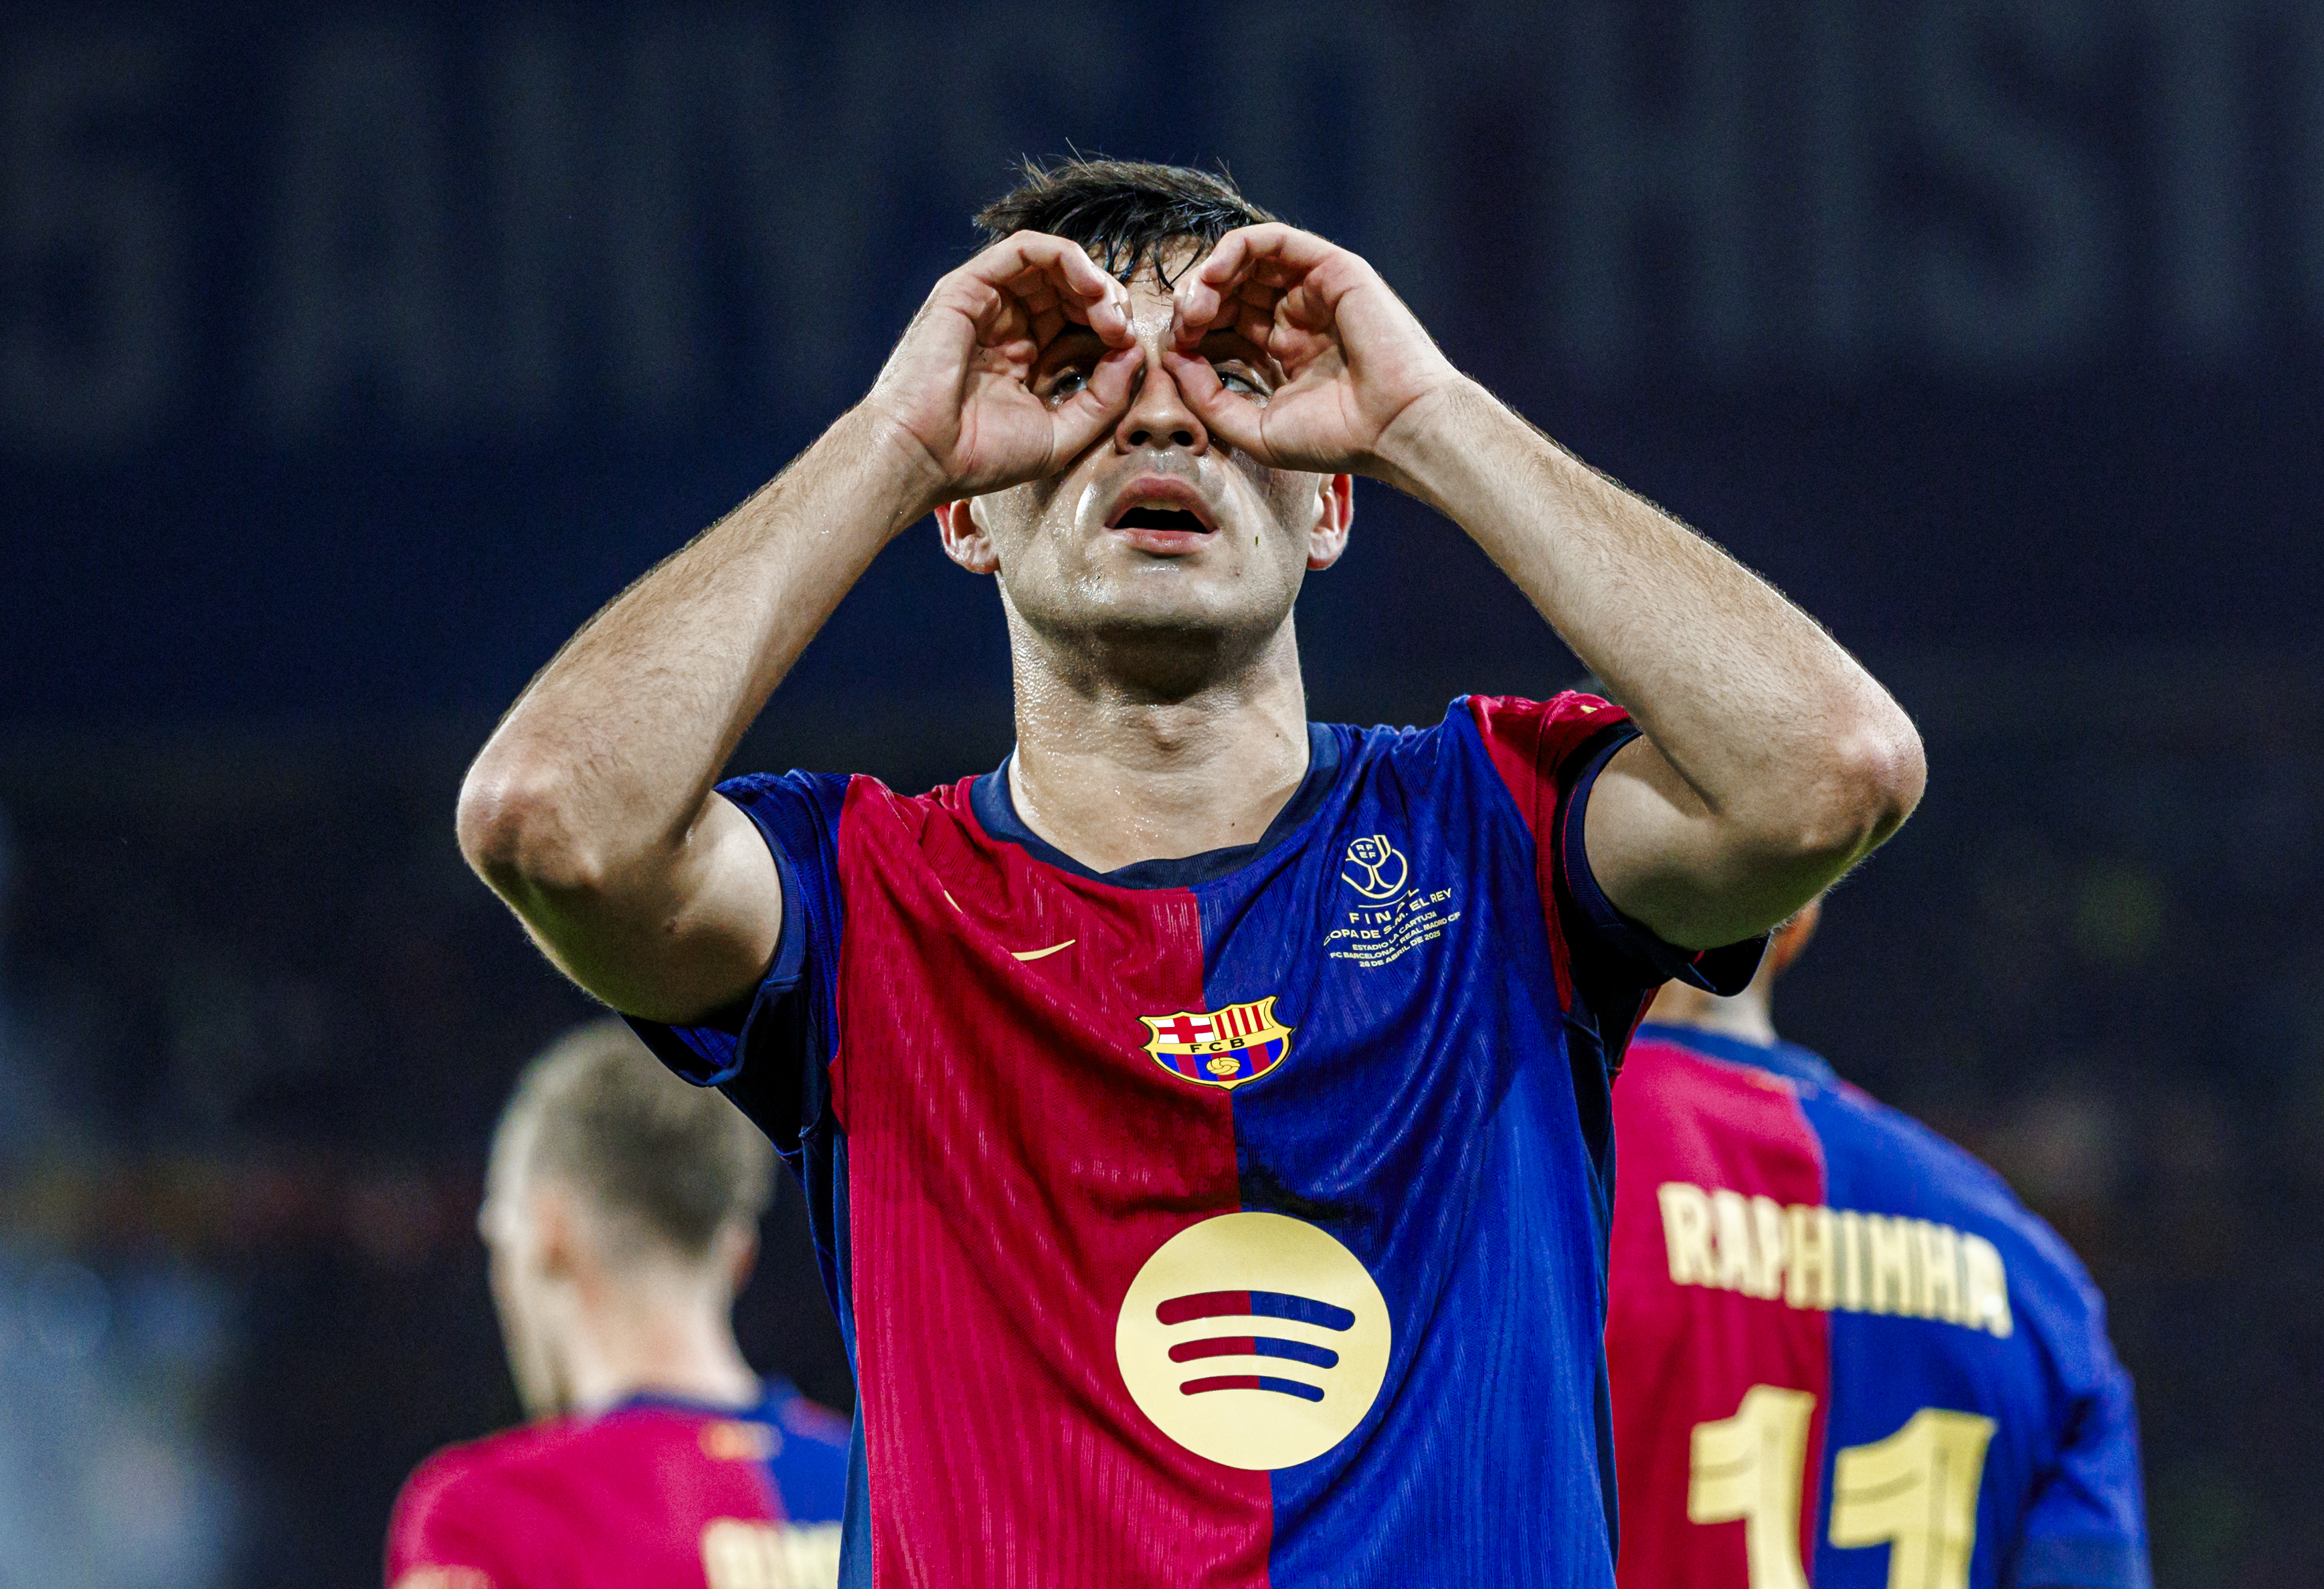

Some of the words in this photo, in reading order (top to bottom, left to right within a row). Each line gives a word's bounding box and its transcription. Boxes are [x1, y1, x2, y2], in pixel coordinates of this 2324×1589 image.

[1342, 946, 1396, 959] BARCELONA
[1399, 927, 1424, 944] REAL
[1447, 911, 1461, 923] CF
[1352, 941, 1389, 951] ESTADIO
[1389, 933, 1400, 944] LA
[1399, 911, 1437, 935] CARTUJA
[1360, 929, 1382, 940] DE
[1383, 913, 1409, 935] S.M.
[1409, 897, 1431, 912] EL
[1429, 887, 1452, 903] REY
[1370, 959, 1385, 967] DE
[1385, 945, 1411, 963] ABRIL
[1409, 935, 1425, 947] DE
[1424, 930, 1441, 941] 2025
[1190, 1038, 1245, 1053] FCB
[1658, 1182, 2014, 1338] RAPHINHA
